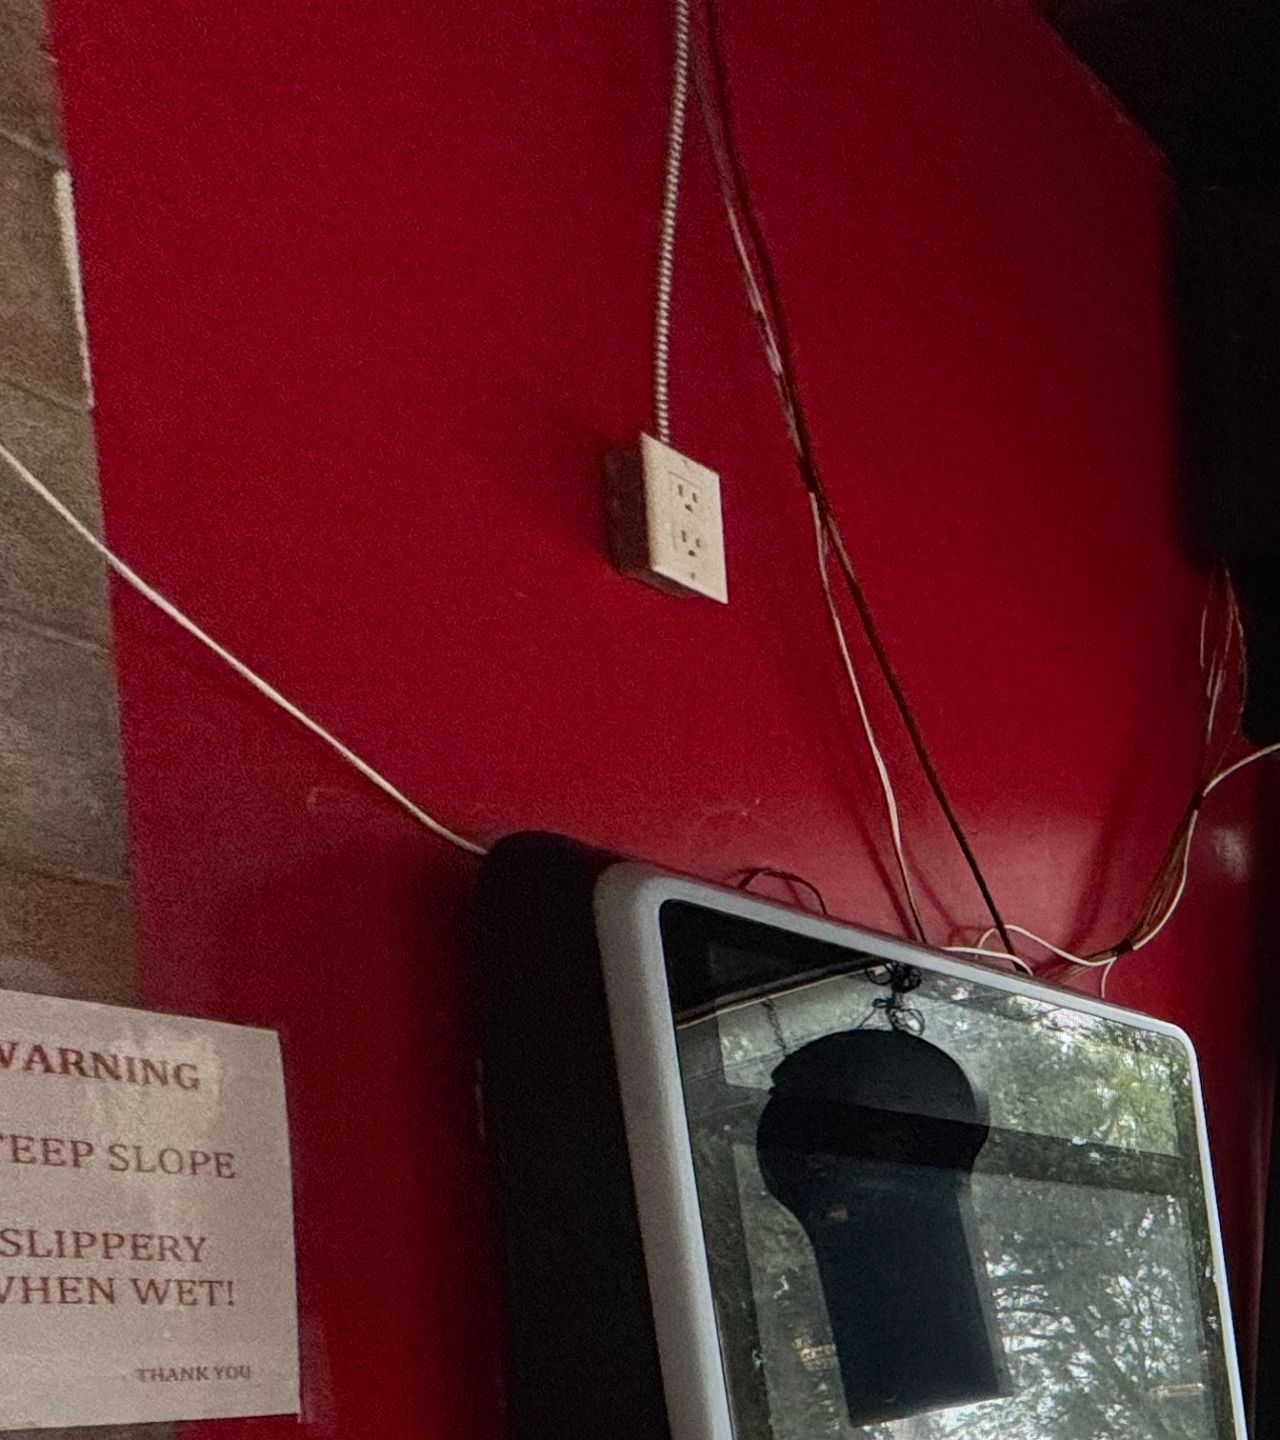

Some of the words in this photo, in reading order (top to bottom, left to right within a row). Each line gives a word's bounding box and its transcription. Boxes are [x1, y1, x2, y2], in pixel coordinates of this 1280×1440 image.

[0, 1134, 95, 1168] EEP
[107, 1143, 236, 1179] SLOPE
[0, 1228, 207, 1262] SLIPPERY
[128, 1278, 235, 1307] WET!
[136, 1366, 209, 1383] THANK
[213, 1365, 250, 1380] YOU
